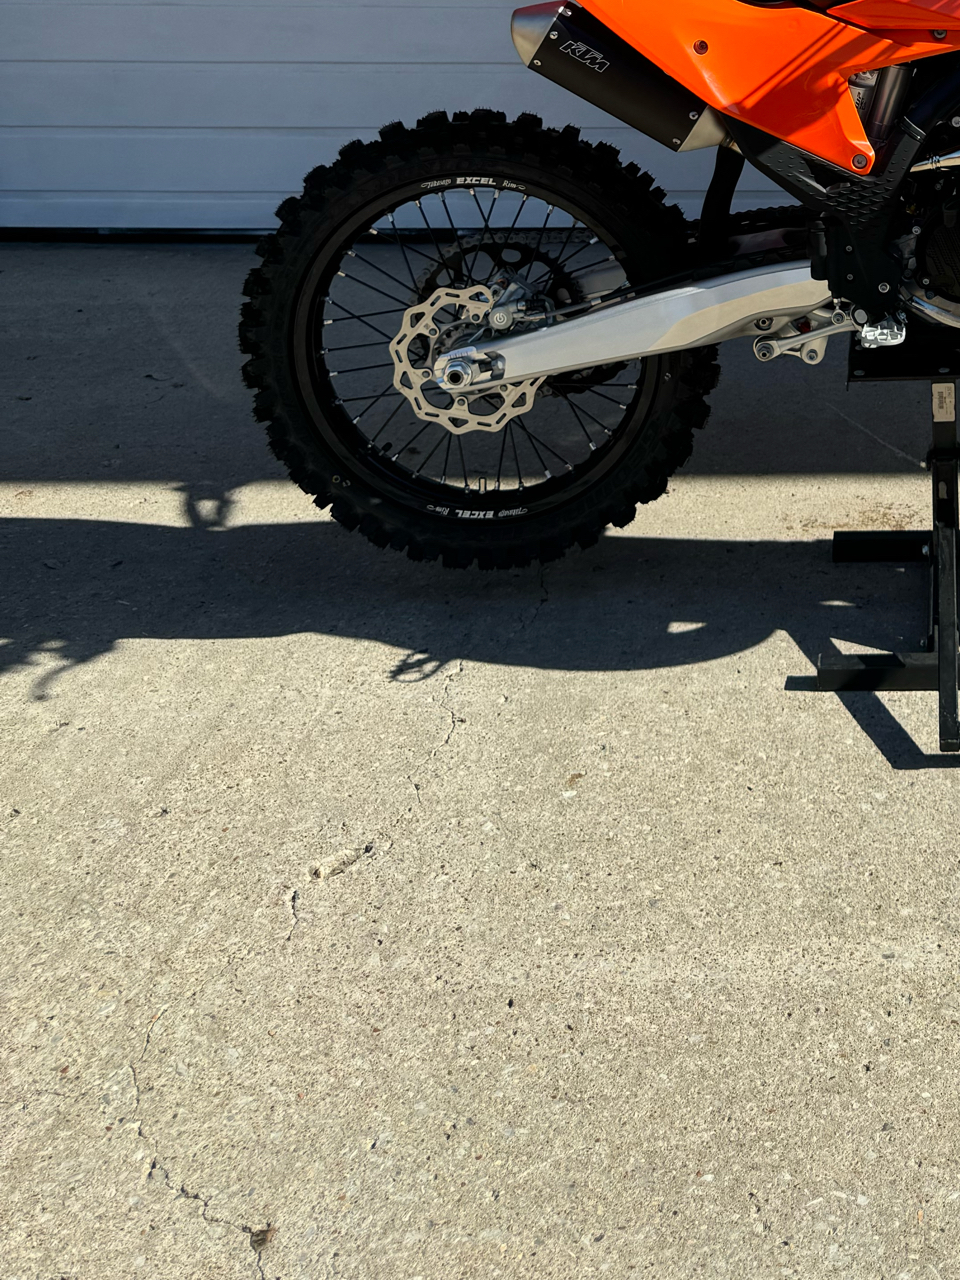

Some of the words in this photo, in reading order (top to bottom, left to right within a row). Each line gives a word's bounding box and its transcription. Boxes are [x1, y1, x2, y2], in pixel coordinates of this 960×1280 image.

[559, 40, 610, 73] KTM
[456, 176, 497, 186] EXCEL
[455, 508, 495, 519] EXCEL
